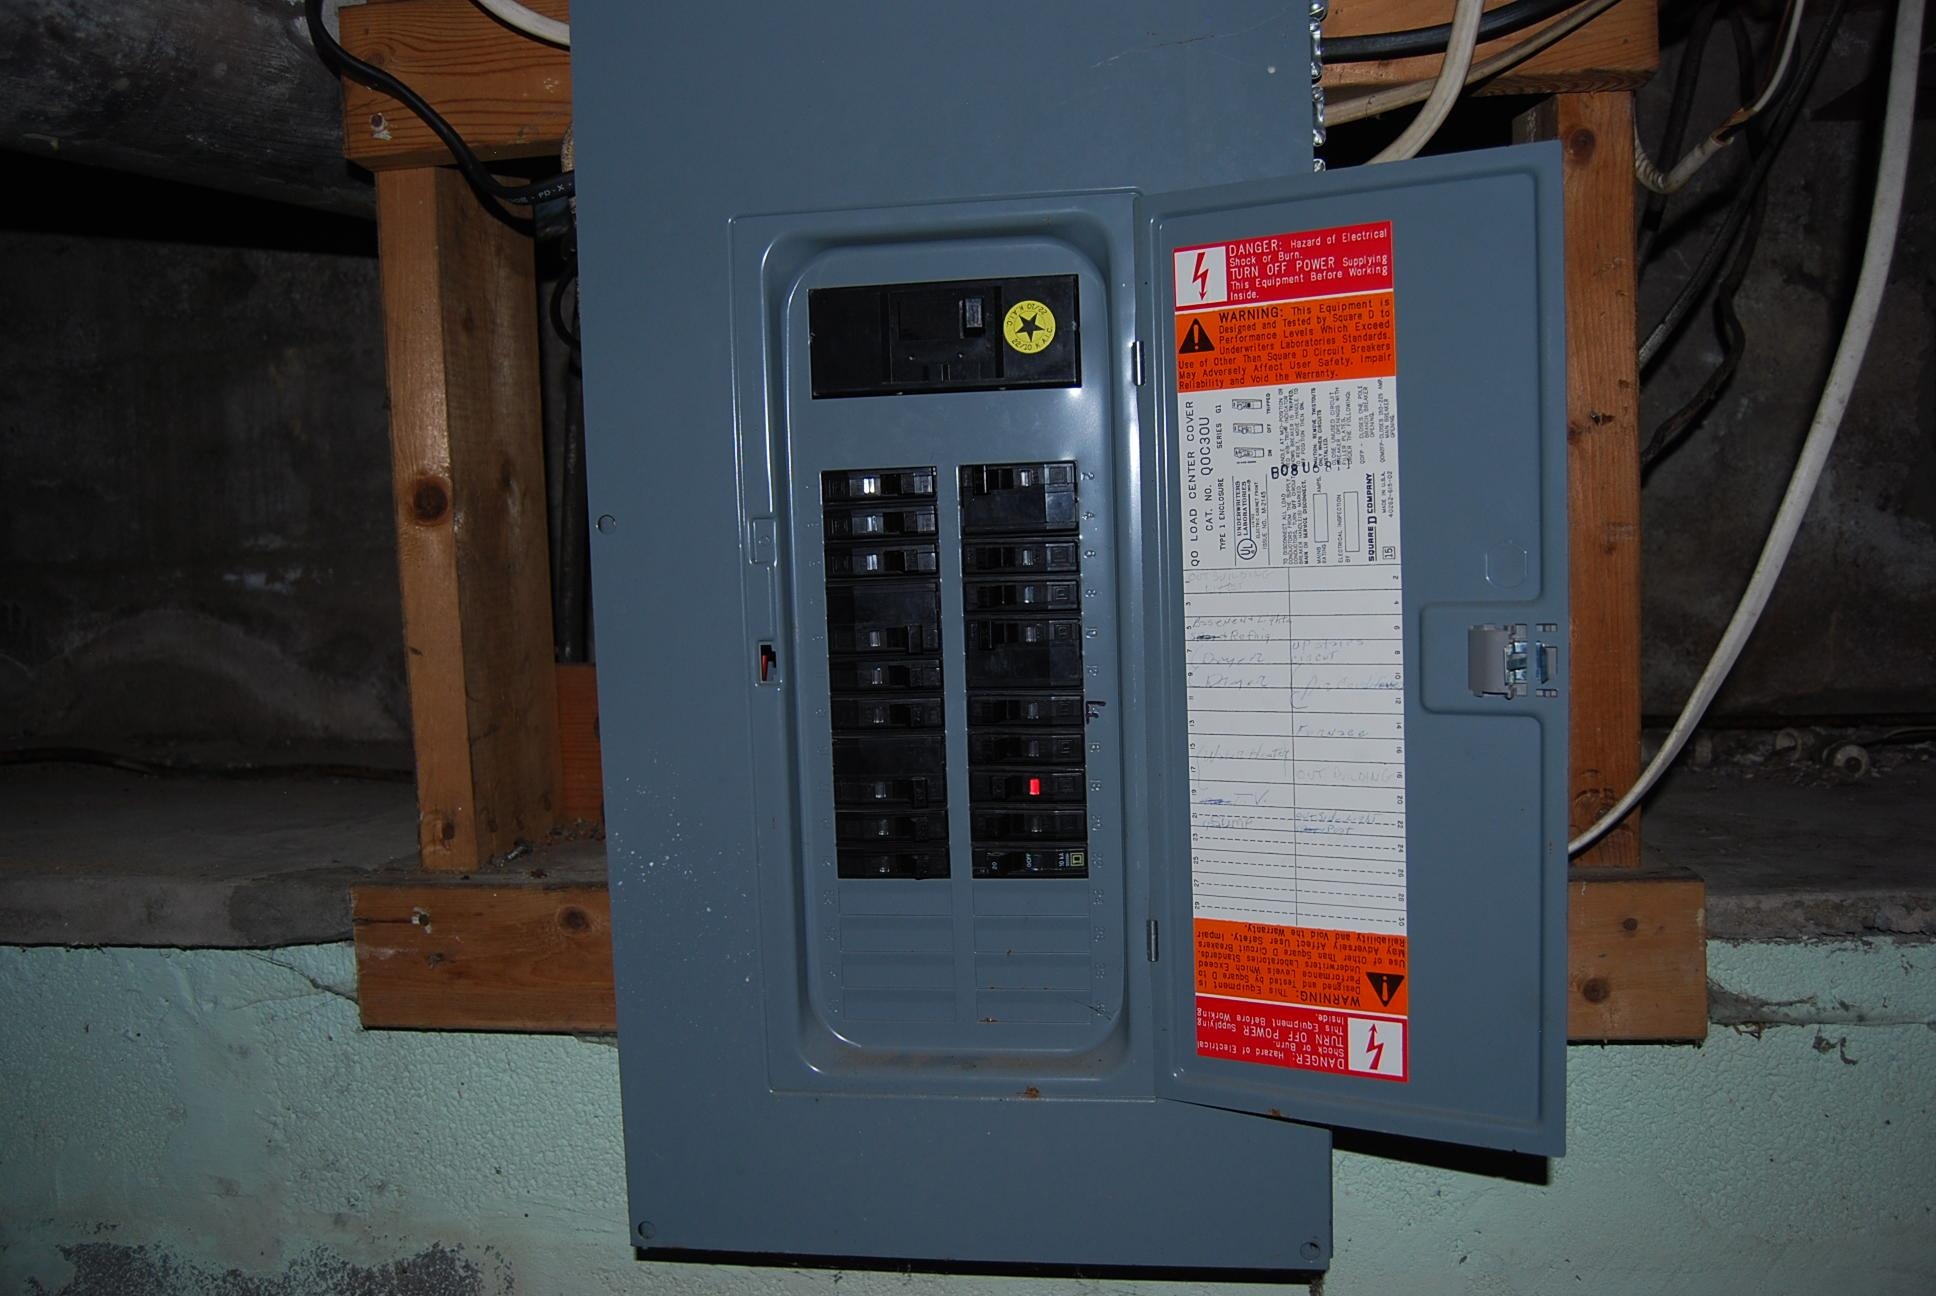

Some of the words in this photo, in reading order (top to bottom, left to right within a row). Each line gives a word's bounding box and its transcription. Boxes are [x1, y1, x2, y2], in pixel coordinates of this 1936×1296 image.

[1229, 239, 1282, 256] DANGER:
[1290, 237, 1320, 248] Hazard
[1326, 234, 1335, 243] of
[1342, 228, 1386, 241] Electrical
[1229, 256, 1255, 266] Shock
[1278, 250, 1302, 260] Burn.
[1230, 266, 1258, 279] TURN
[1267, 262, 1286, 275] OFF
[1296, 257, 1334, 272] POWER
[1342, 253, 1387, 268] Supplying
[1230, 280, 1248, 289] This
[1255, 274, 1303, 288] Equipment
[1310, 270, 1342, 281] Before
[1349, 264, 1387, 278] Working
[1231, 289, 1258, 300] Inside.
[1219, 306, 1283, 323] WARNING:
[1292, 306, 1312, 315] This
[1319, 299, 1373, 314] Equipment
[1379, 297, 1389, 307] is
[1219, 322, 1255, 334] Designed
[1262, 320, 1276, 329] and
[1283, 317, 1310, 327] Tested
[1316, 314, 1325, 325] by
[1332, 312, 1362, 323] Square
[1368, 310, 1374, 319] D
[1380, 308, 1390, 318] to
[1219, 331, 1276, 343] Performance
[1283, 328, 1313, 337] Levels
[1320, 324, 1347, 334] Which
[1355, 320, 1389, 331] Exceed
[1219, 342, 1274, 354] Underwriters
[1280, 336, 1335, 348] Laboratories
[1342, 331, 1390, 343] Standards.
[1178, 359, 1194, 369] Use
[1199, 358, 1208, 367] of
[1214, 356, 1236, 365] Other
[1243, 354, 1260, 363] Than
[1267, 350, 1296, 362] Square
[1302, 349, 1307, 358] D
[1313, 347, 1343, 357] Circuit
[1351, 342, 1390, 352] Breakers
[1178, 370, 1195, 379] May
[1202, 365, 1246, 377] Adversely
[1253, 362, 1282, 372] Affect
[1289, 359, 1310, 369] User
[1360, 353, 1391, 363] Impair
[1179, 378, 1223, 390] Reliability
[1230, 375, 1244, 385] and
[1251, 373, 1268, 383] Void
[1274, 372, 1288, 382] the
[1295, 368, 1337, 380] Warranty.
[1215, 404, 1221, 413] G1
[1185, 400, 1195, 441] COVER
[1187, 451, 1197, 498] CENTER
[1204, 484, 1212, 501] NO.
[1189, 508, 1198, 541] LOAD
[1204, 508, 1213, 530] CAT.
[1367, 516, 1376, 524] D
[1241, 543, 1253, 555] UL
[1190, 550, 1199, 566] QO
[1197, 931, 1224, 940] Impair
[1244, 924, 1284, 936] Warranty.
[1290, 928, 1304, 938] the
[1310, 930, 1328, 940] Void
[1269, 937, 1289, 946] User
[1335, 932, 1349, 942] and
[1356, 934, 1404, 946] Reliability
[1198, 941, 1231, 950] Breakers
[1238, 944, 1266, 954] Circuit
[1296, 940, 1325, 949] Affect
[1333, 942, 1378, 954] Adversely
[1198, 950, 1240, 961] Standards.
[1272, 947, 1277, 955] D
[1283, 948, 1311, 958] Square
[1318, 951, 1336, 961] Than
[1386, 947, 1405, 956] May
[1246, 955, 1298, 966] Laboratories
[1344, 954, 1366, 963] Other
[1373, 956, 1381, 965] of
[1388, 957, 1405, 967] Use
[1198, 960, 1228, 970] Exceed
[1235, 964, 1260, 973] Which
[1304, 960, 1360, 972] Underwriters
[1198, 969, 1206, 977] to
[1212, 970, 1217, 978] D
[1222, 971, 1248, 981] Square
[1267, 967, 1295, 976] Levels
[1302, 970, 1359, 983] Performance
[1198, 979, 1206, 988] is
[1254, 974, 1263, 983] by
[1269, 977, 1295, 986] Tested
[1302, 979, 1316, 989] and
[1213, 980, 1261, 993] Equipment
[1266, 987, 1286, 996] This
[1322, 980, 1360, 993] Designed
[1295, 990, 1360, 1006] WARNING:
[1196, 1008, 1230, 1020] Working
[1236, 1014, 1264, 1025] Before
[1315, 1014, 1343, 1024] Inside.
[1196, 1018, 1235, 1031] Supplying
[1272, 1016, 1318, 1031] Equipment
[1324, 1024, 1343, 1034] This
[1243, 1026, 1278, 1038] POWER
[1288, 1031, 1306, 1042] OFF
[1272, 1040, 1295, 1050] Burn.
[1315, 1034, 1343, 1046] TURN
[1197, 1041, 1236, 1052] Electrical
[1242, 1045, 1250, 1055] of
[1318, 1046, 1344, 1056] Shock
[1254, 1048, 1283, 1058] Hazard
[1292, 1052, 1344, 1069] DANGER:
